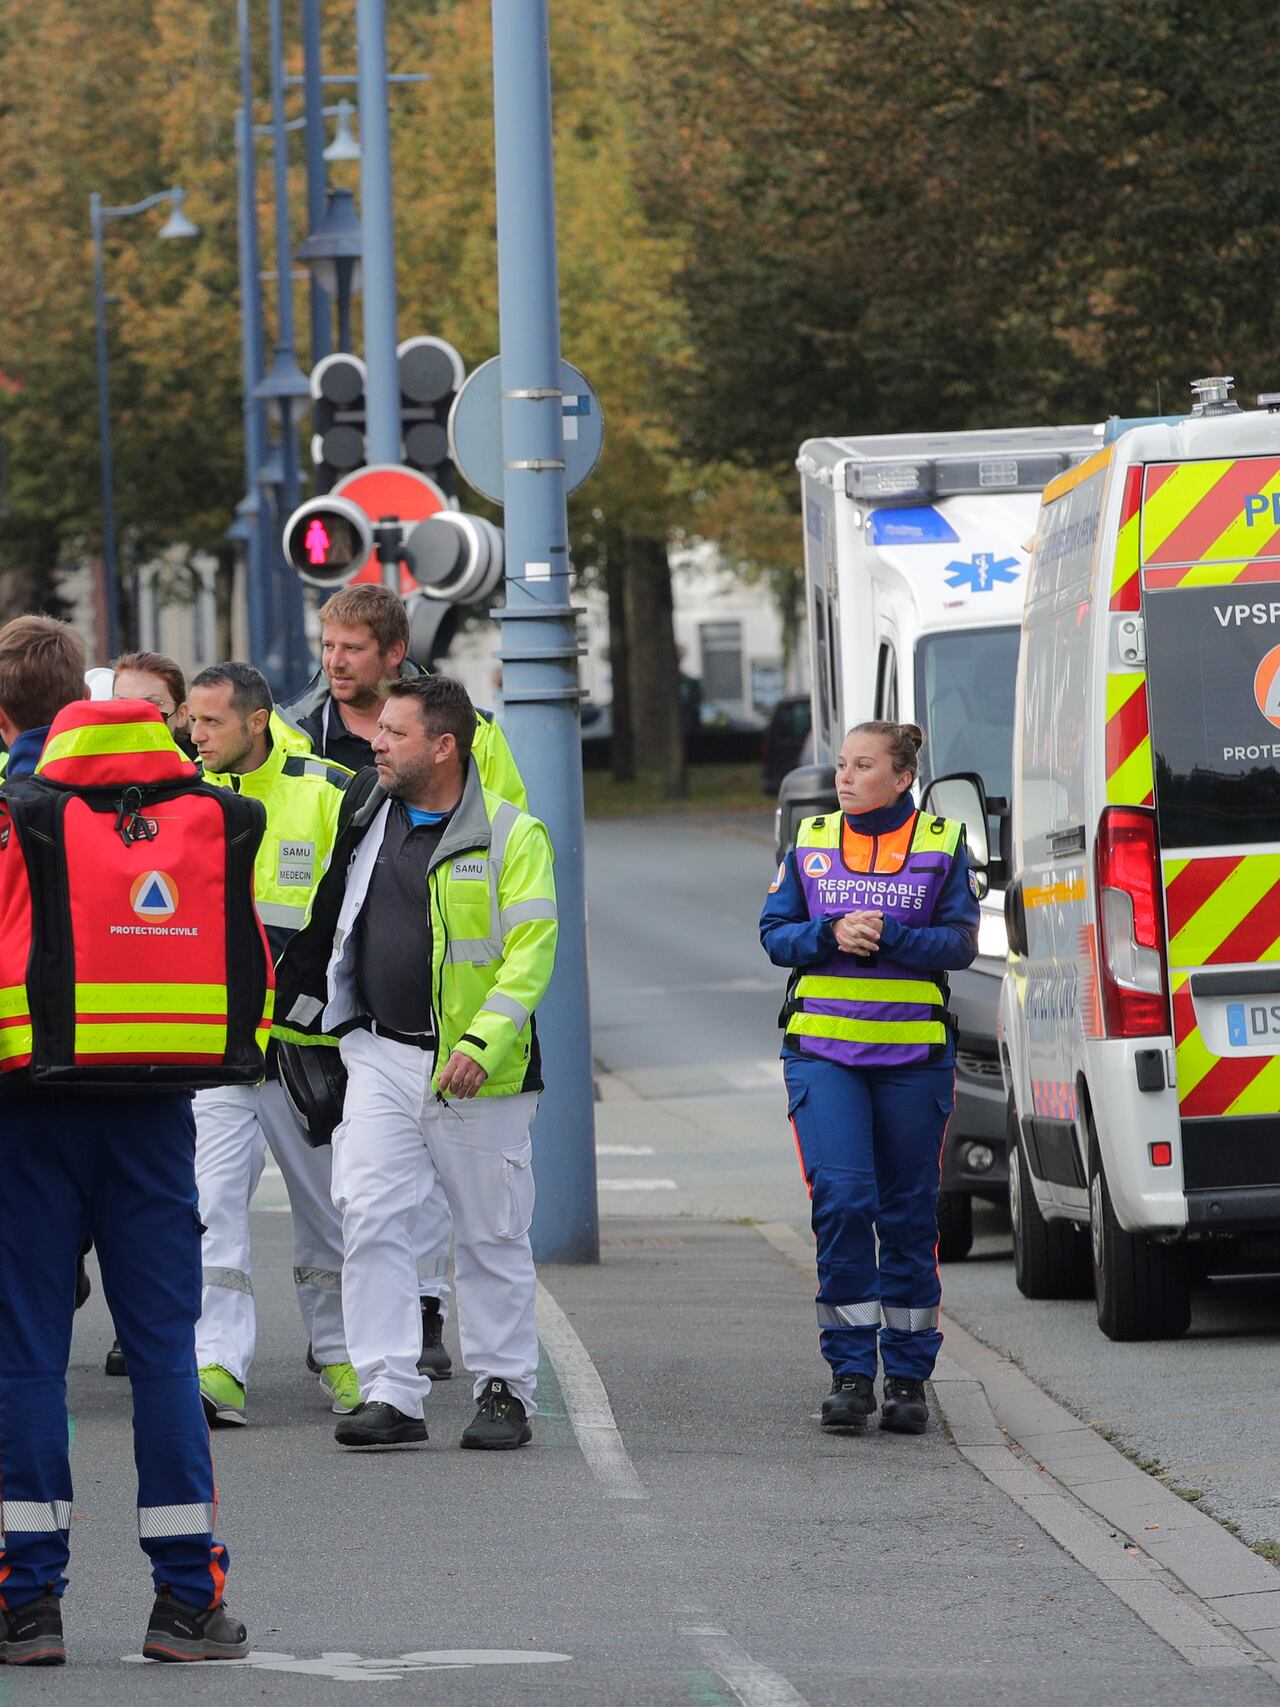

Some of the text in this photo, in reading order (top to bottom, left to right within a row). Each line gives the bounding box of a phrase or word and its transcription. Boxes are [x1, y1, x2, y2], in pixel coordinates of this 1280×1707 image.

[1223, 744, 1280, 761] PROTE
[282, 847, 311, 857] SAMU
[455, 864, 483, 874] SAMU
[279, 870, 312, 880] MEDECIN
[817, 879, 927, 898] RESPONSABLE
[819, 891, 923, 910] IMPLIQUES
[110, 925, 199, 936] PROTECTION CIVILE
